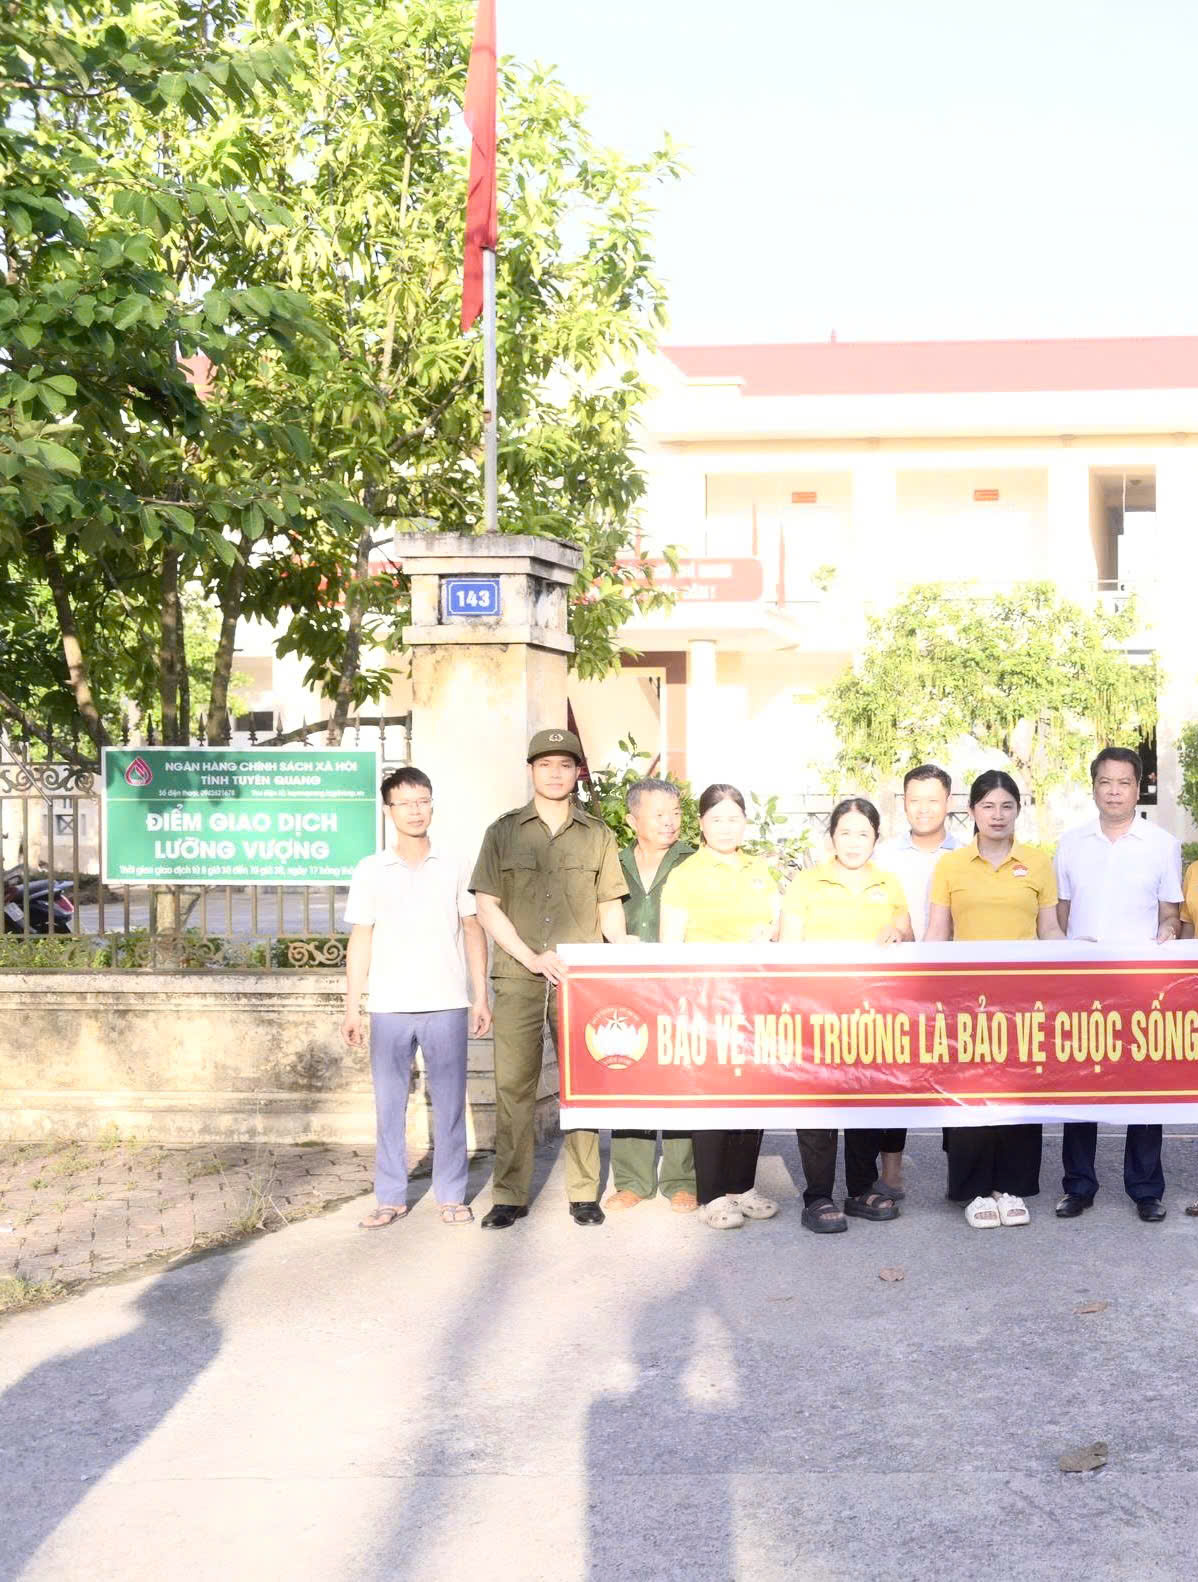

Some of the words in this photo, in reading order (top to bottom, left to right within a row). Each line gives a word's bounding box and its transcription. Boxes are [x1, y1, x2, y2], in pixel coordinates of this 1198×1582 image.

[457, 589, 490, 607] 143
[164, 760, 200, 772] NGÂN
[203, 760, 237, 772] HÀNG
[239, 760, 278, 772] CHÍNH
[279, 760, 313, 772] SÁCH
[315, 760, 333, 772] XÃ
[232, 774, 271, 785] TUYÊN
[274, 775, 321, 786] QUANG
[146, 804, 202, 832] ĐIỂM
[209, 813, 272, 832] GIAO
[278, 812, 338, 836] DỊCH
[154, 836, 236, 860] LƯỠNG
[242, 840, 330, 864] VƯỢNG
[657, 998, 707, 1066] BẢO
[716, 1006, 747, 1077] VỆ
[754, 1003, 803, 1066] MÔI
[811, 1000, 910, 1066] TRƯỜNG
[919, 1001, 949, 1064] LÀ
[958, 994, 1008, 1064] BẢO
[1016, 1001, 1047, 1074] VỆ
[1055, 1000, 1123, 1074] CUỘC
